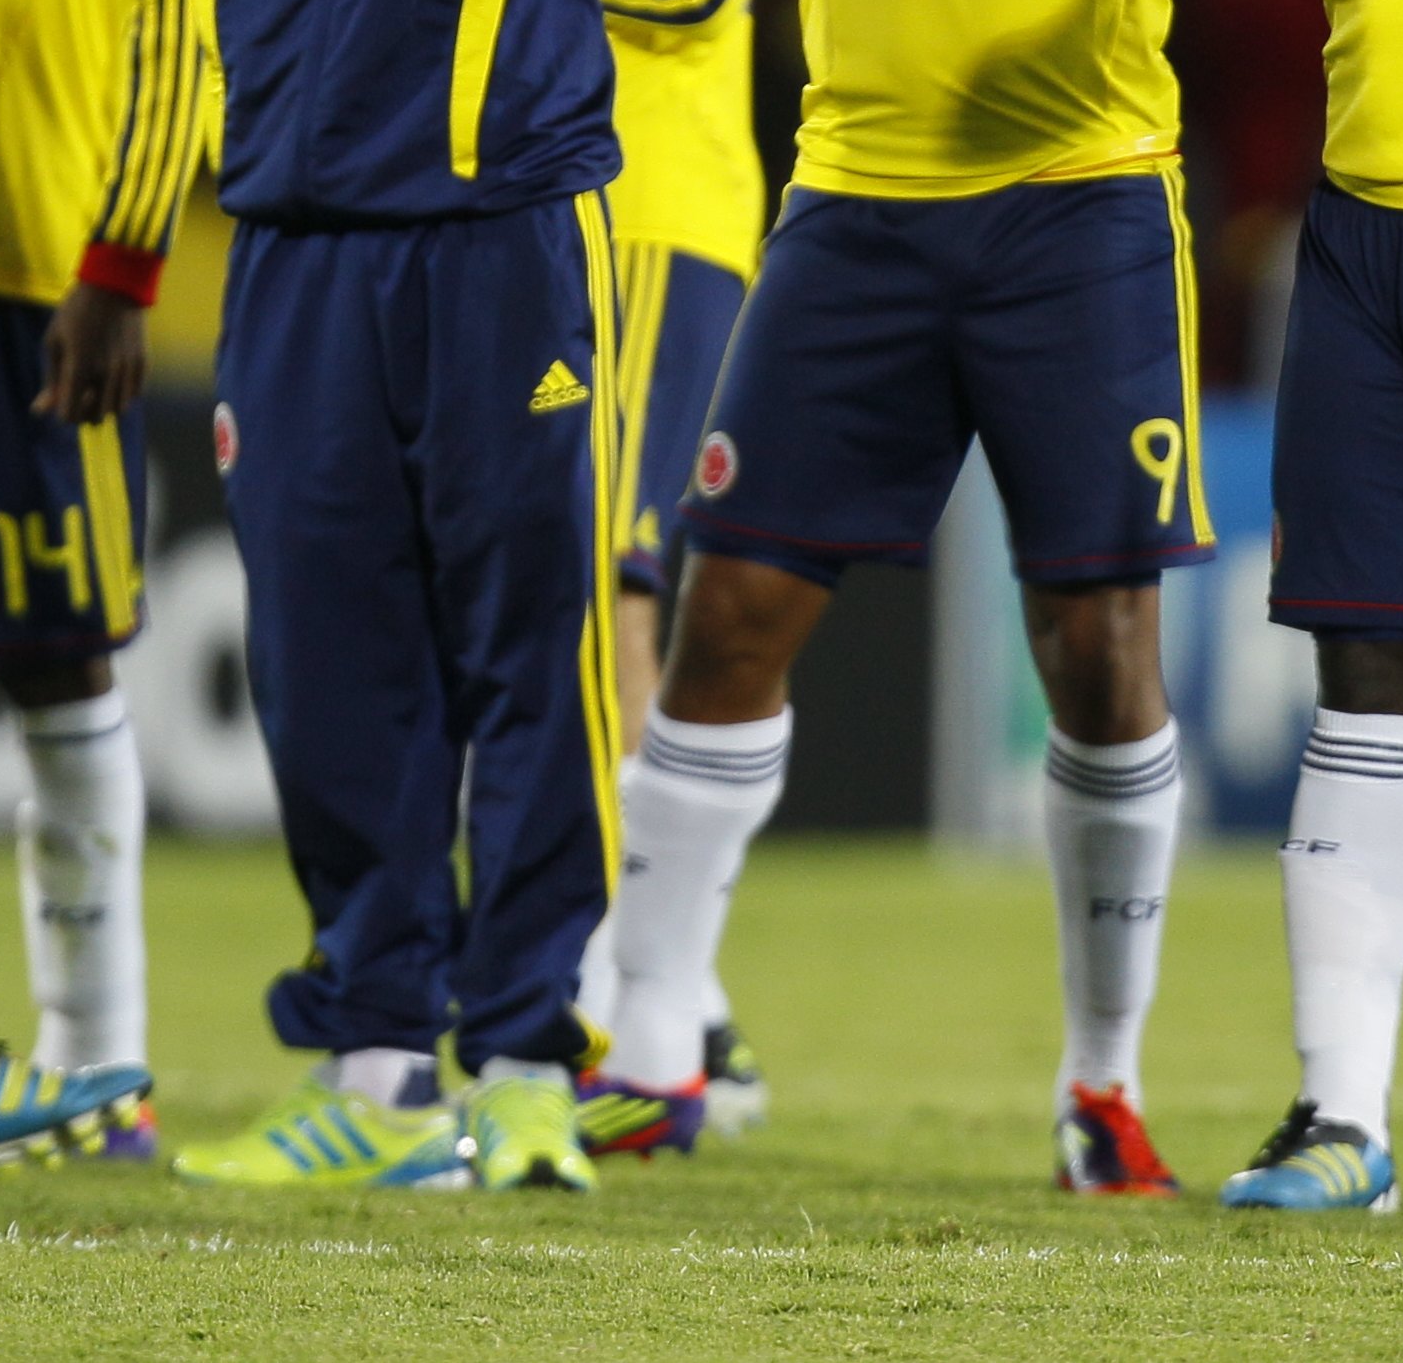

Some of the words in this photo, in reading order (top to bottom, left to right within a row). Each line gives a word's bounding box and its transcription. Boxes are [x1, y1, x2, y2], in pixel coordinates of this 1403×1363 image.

[529, 384, 590, 413] adidas
[1131, 417, 1182, 525] 9
[1279, 838, 1341, 853] CF
